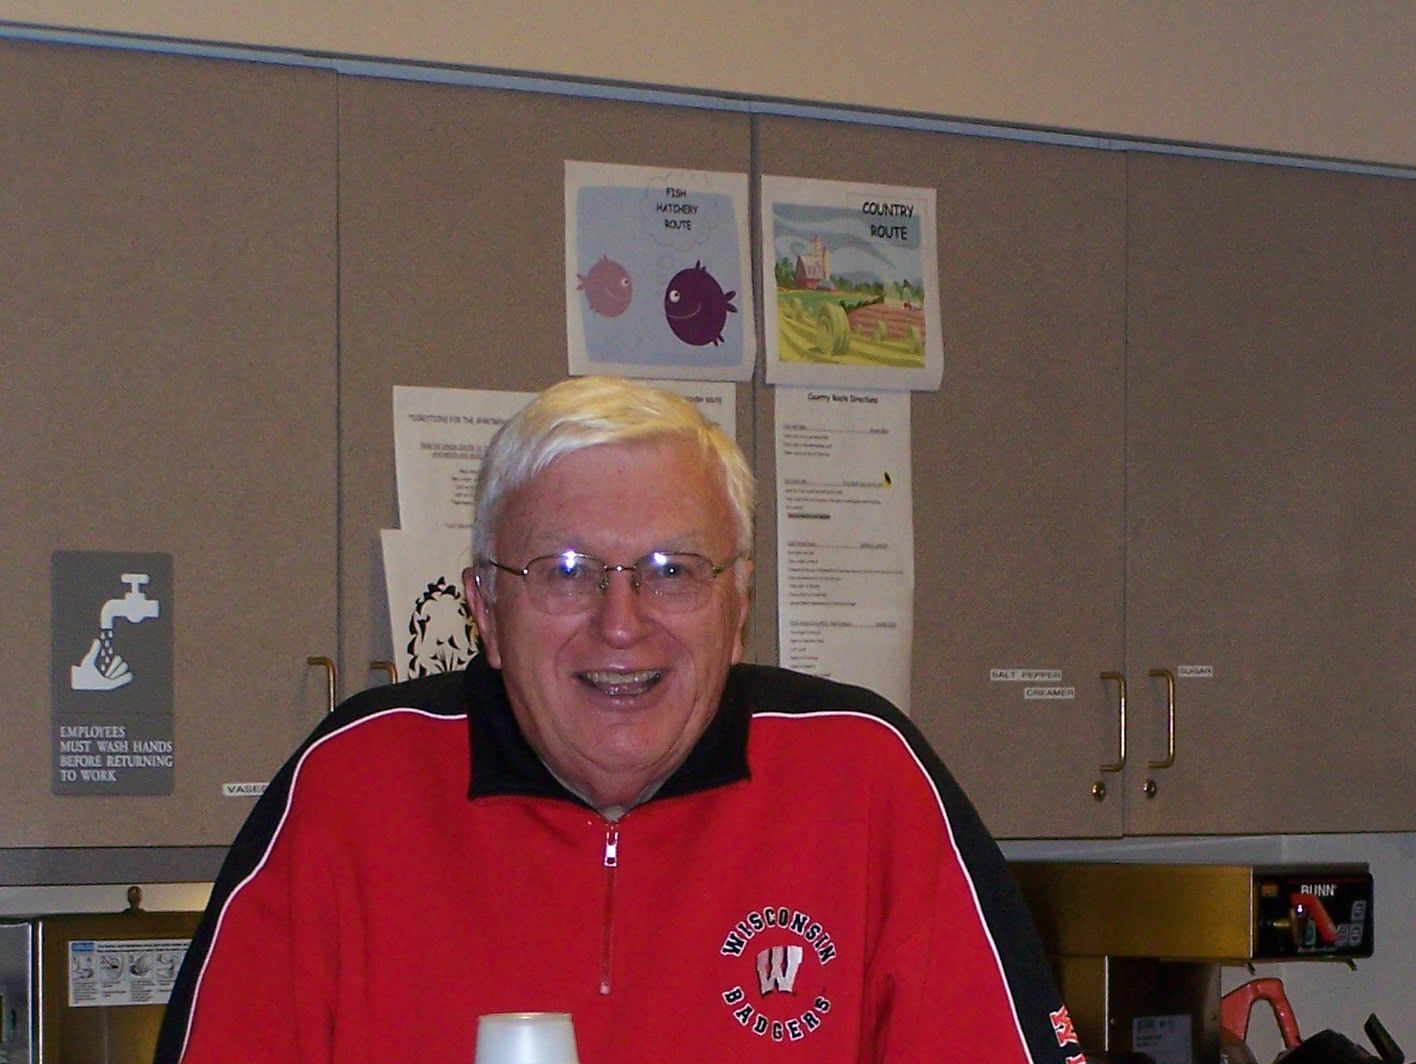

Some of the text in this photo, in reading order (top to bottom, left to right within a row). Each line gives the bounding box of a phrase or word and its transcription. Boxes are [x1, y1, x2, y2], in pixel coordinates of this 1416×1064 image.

[666, 187, 687, 198] FISH
[656, 203, 698, 214] HATCHERY
[862, 201, 914, 218] COUNTRY
[664, 219, 692, 231] ROUTE
[870, 223, 908, 240] ROUTE
[1026, 689, 1074, 697] CREAMER
[60, 726, 126, 738] EMPLOYEES
[60, 741, 173, 753] MUST WASH HANDS
[60, 755, 173, 767] BEFORE RETURNING
[60, 769, 117, 782] TO WORK
[720, 906, 837, 966] WISCONSIN
[756, 945, 804, 995] W
[722, 985, 831, 1042] BADGERS
